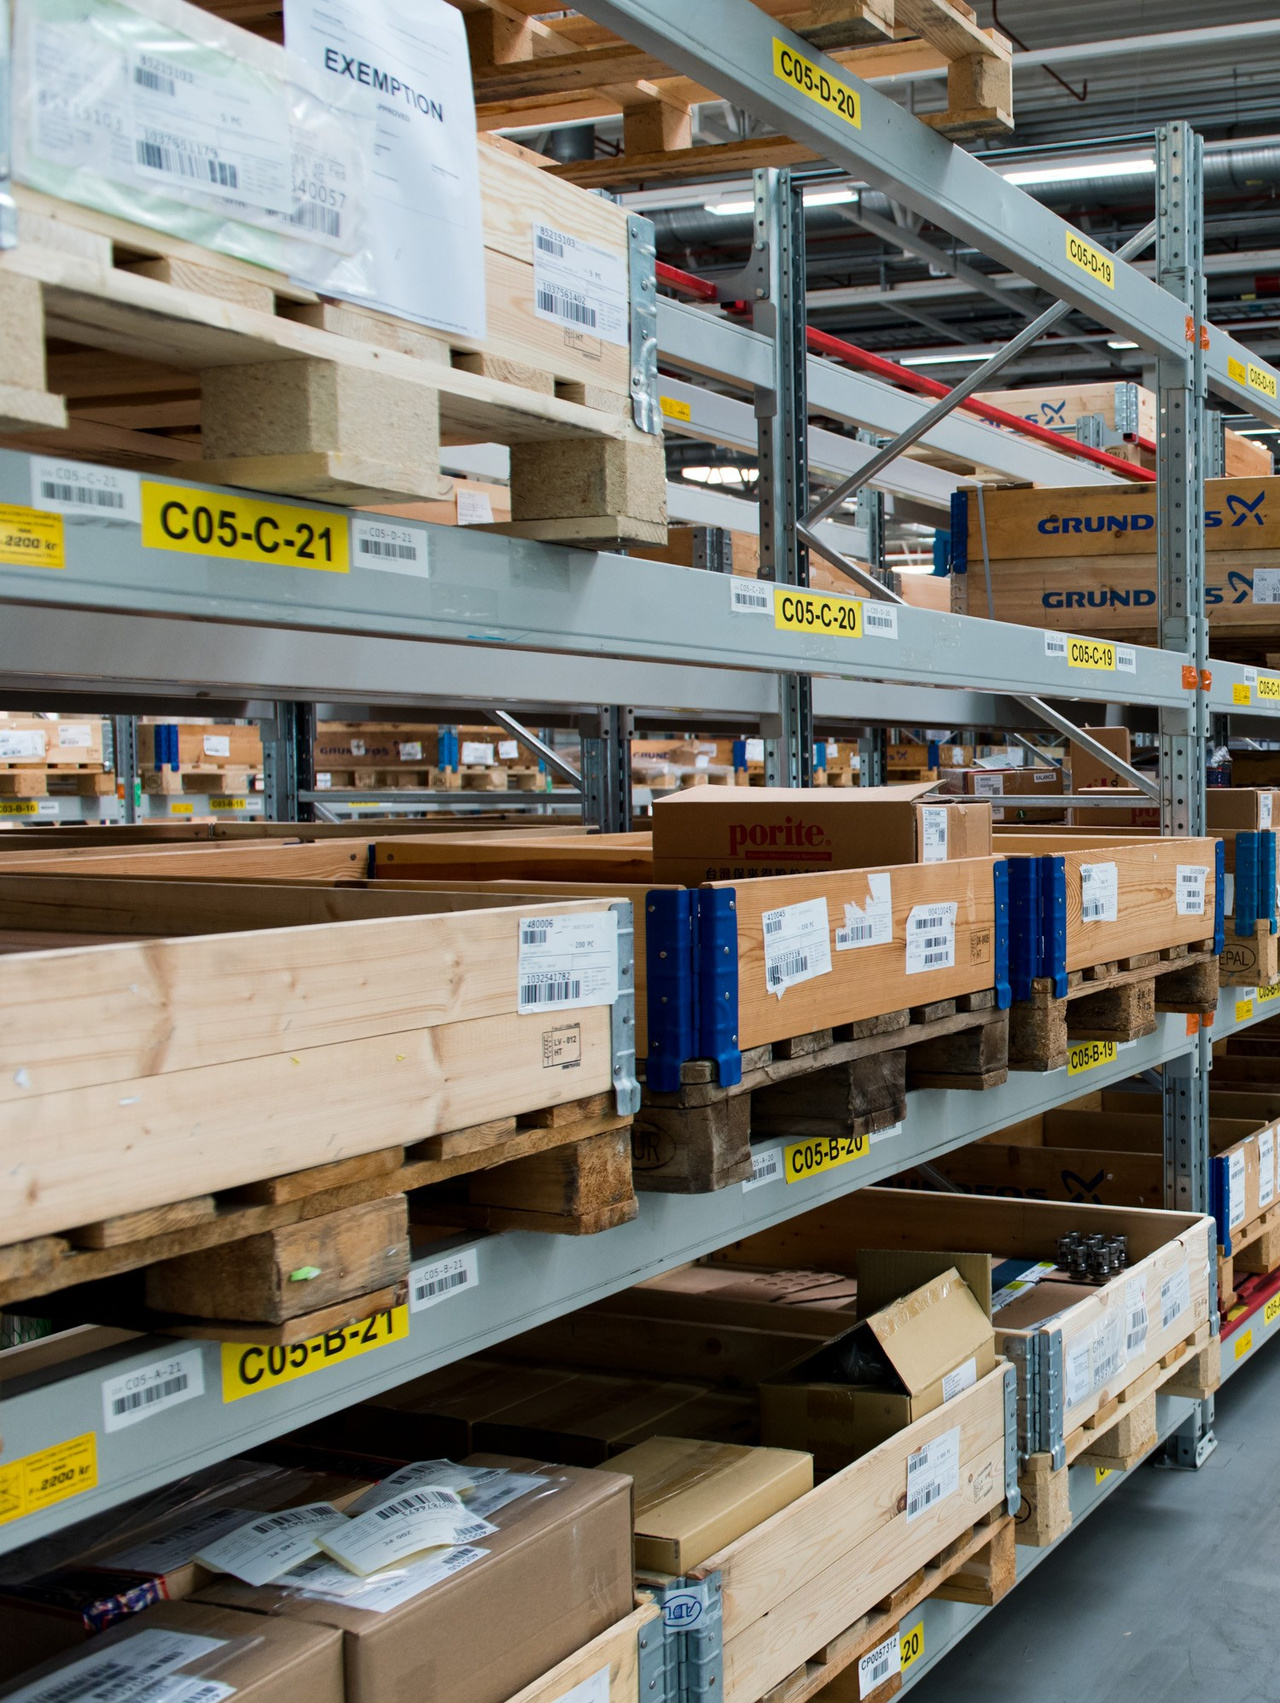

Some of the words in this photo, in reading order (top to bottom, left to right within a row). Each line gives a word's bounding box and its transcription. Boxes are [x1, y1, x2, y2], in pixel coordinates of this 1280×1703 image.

[324, 47, 444, 123] EXEMPTION
[779, 49, 856, 120] C05-D-20
[376, 103, 412, 122] PPROVED
[540, 226, 576, 249] 85215103
[1069, 238, 1112, 283] C05-D-19
[542, 281, 587, 306] 1037561402
[1250, 367, 1276, 396] C05-D-18
[160, 499, 333, 563] C05-C-21
[369, 526, 413, 543] C05-D-21
[1037, 511, 1222, 536] GRUNDS
[44, 539, 57, 551] kr
[1041, 586, 1224, 610] GRUNDS
[782, 596, 856, 631] C05-C-20
[1072, 643, 1113, 666] C05-C-19
[728, 816, 826, 857] porite
[705, 867, 829, 880] 台灣保來得股份
[767, 910, 786, 921] 410045
[927, 905, 952, 917] 00410045
[526, 919, 554, 929] 480006
[526, 971, 571, 985] 1032541782
[1071, 1040, 1114, 1070] C05-B-19
[752, 1153, 774, 1168] 05-A-20
[791, 1137, 863, 1174] C05-B-20
[424, 1258, 465, 1282] C05-B-21
[238, 1307, 395, 1385] C05-B-21
[125, 1361, 184, 1390] C05-A-21
[40, 1468, 76, 1491] 2200
[78, 1464, 91, 1476] kr
[860, 1637, 898, 1672] CP0057312
